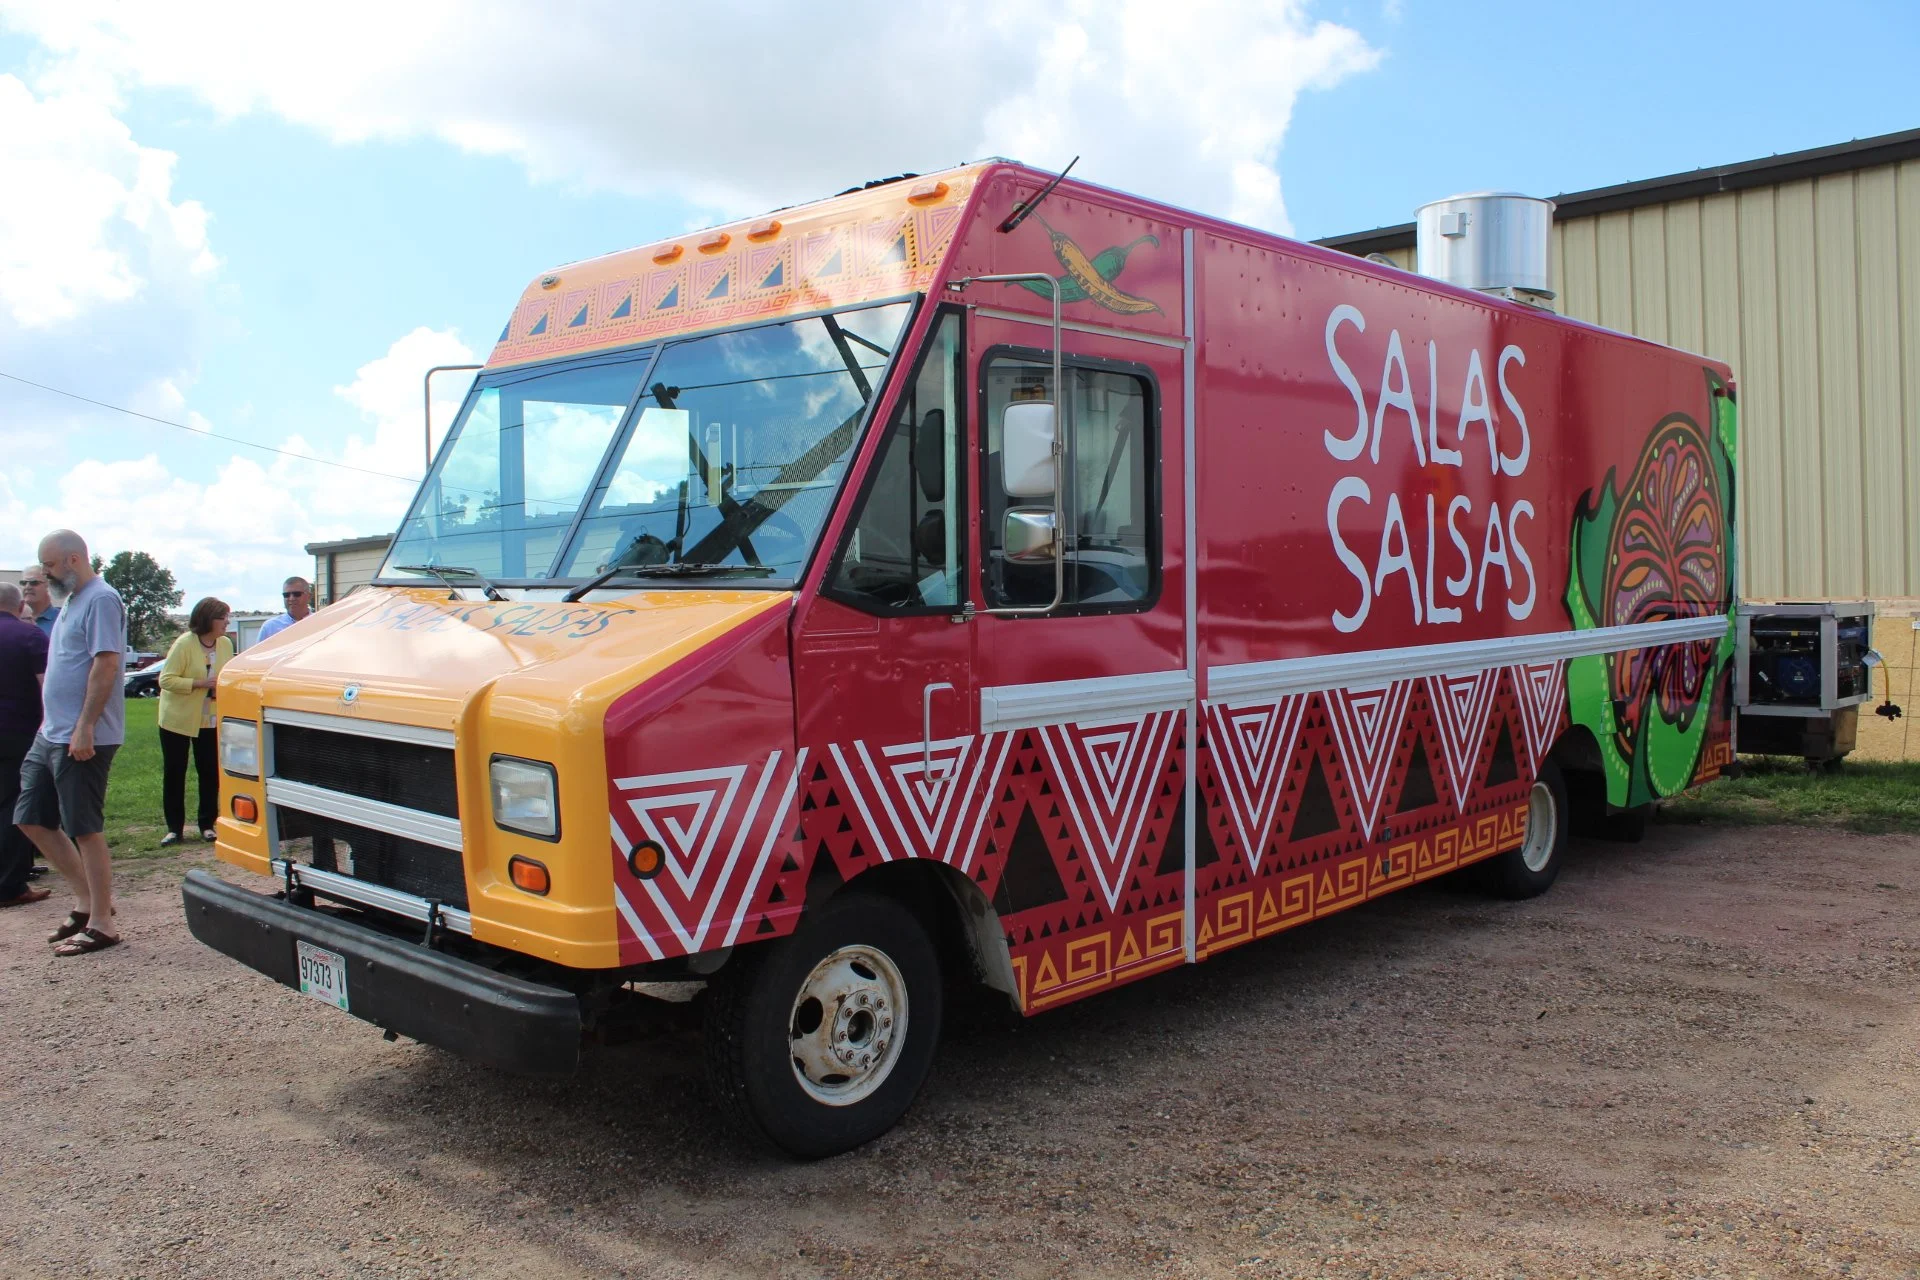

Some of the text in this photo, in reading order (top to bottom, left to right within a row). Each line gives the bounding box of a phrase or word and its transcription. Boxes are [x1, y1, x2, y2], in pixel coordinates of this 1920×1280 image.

[1324, 304, 1531, 477] SALAS
[1327, 476, 1536, 633] SALSAS
[468, 604, 636, 638] SALSAS
[301, 955, 332, 989] 97373
